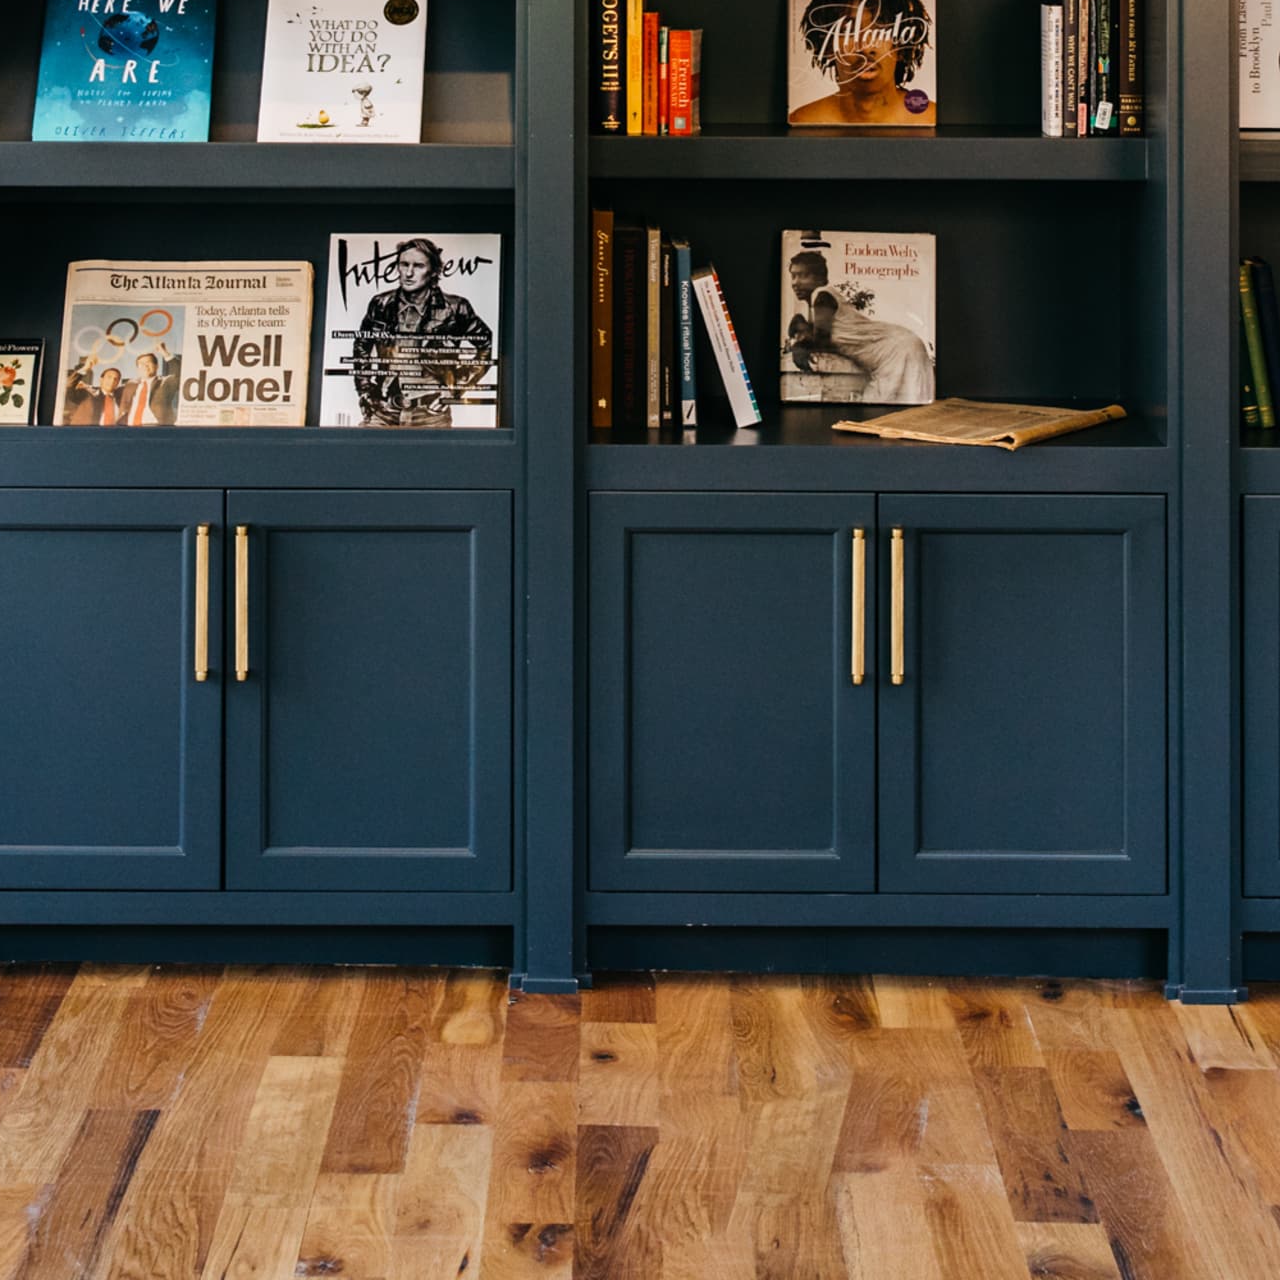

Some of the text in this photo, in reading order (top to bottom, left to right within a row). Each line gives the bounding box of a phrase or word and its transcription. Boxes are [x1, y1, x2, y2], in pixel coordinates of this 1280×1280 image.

[1260, 2, 1272, 27] Paul
[310, 20, 378, 30] WHAT DO
[1128, 19, 1136, 38] FROM
[309, 30, 378, 42] YOU DO
[308, 43, 377, 54] WITH AN
[306, 54, 391, 73] IDEA?
[1128, 54, 1136, 81] FATHER
[1248, 27, 1263, 94] to Brooklyn
[88, 58, 161, 84] ARE
[678, 58, 689, 108] French
[55, 126, 185, 139] OLIVER JEFFERS
[844, 243, 919, 262] Eudora Welty
[844, 262, 920, 280] Photographs
[110, 273, 139, 291] The
[141, 275, 201, 290] Atlanta
[205, 275, 267, 290] Journal
[195, 305, 290, 318] Today, Atlanta tells
[197, 318, 286, 330] its Olympic team:
[681, 280, 692, 382] Knowles ritual house
[355, 331, 390, 339] WILSON
[8, 344, 39, 352] Flowers
[198, 334, 282, 367] Well
[182, 370, 293, 402] done!
